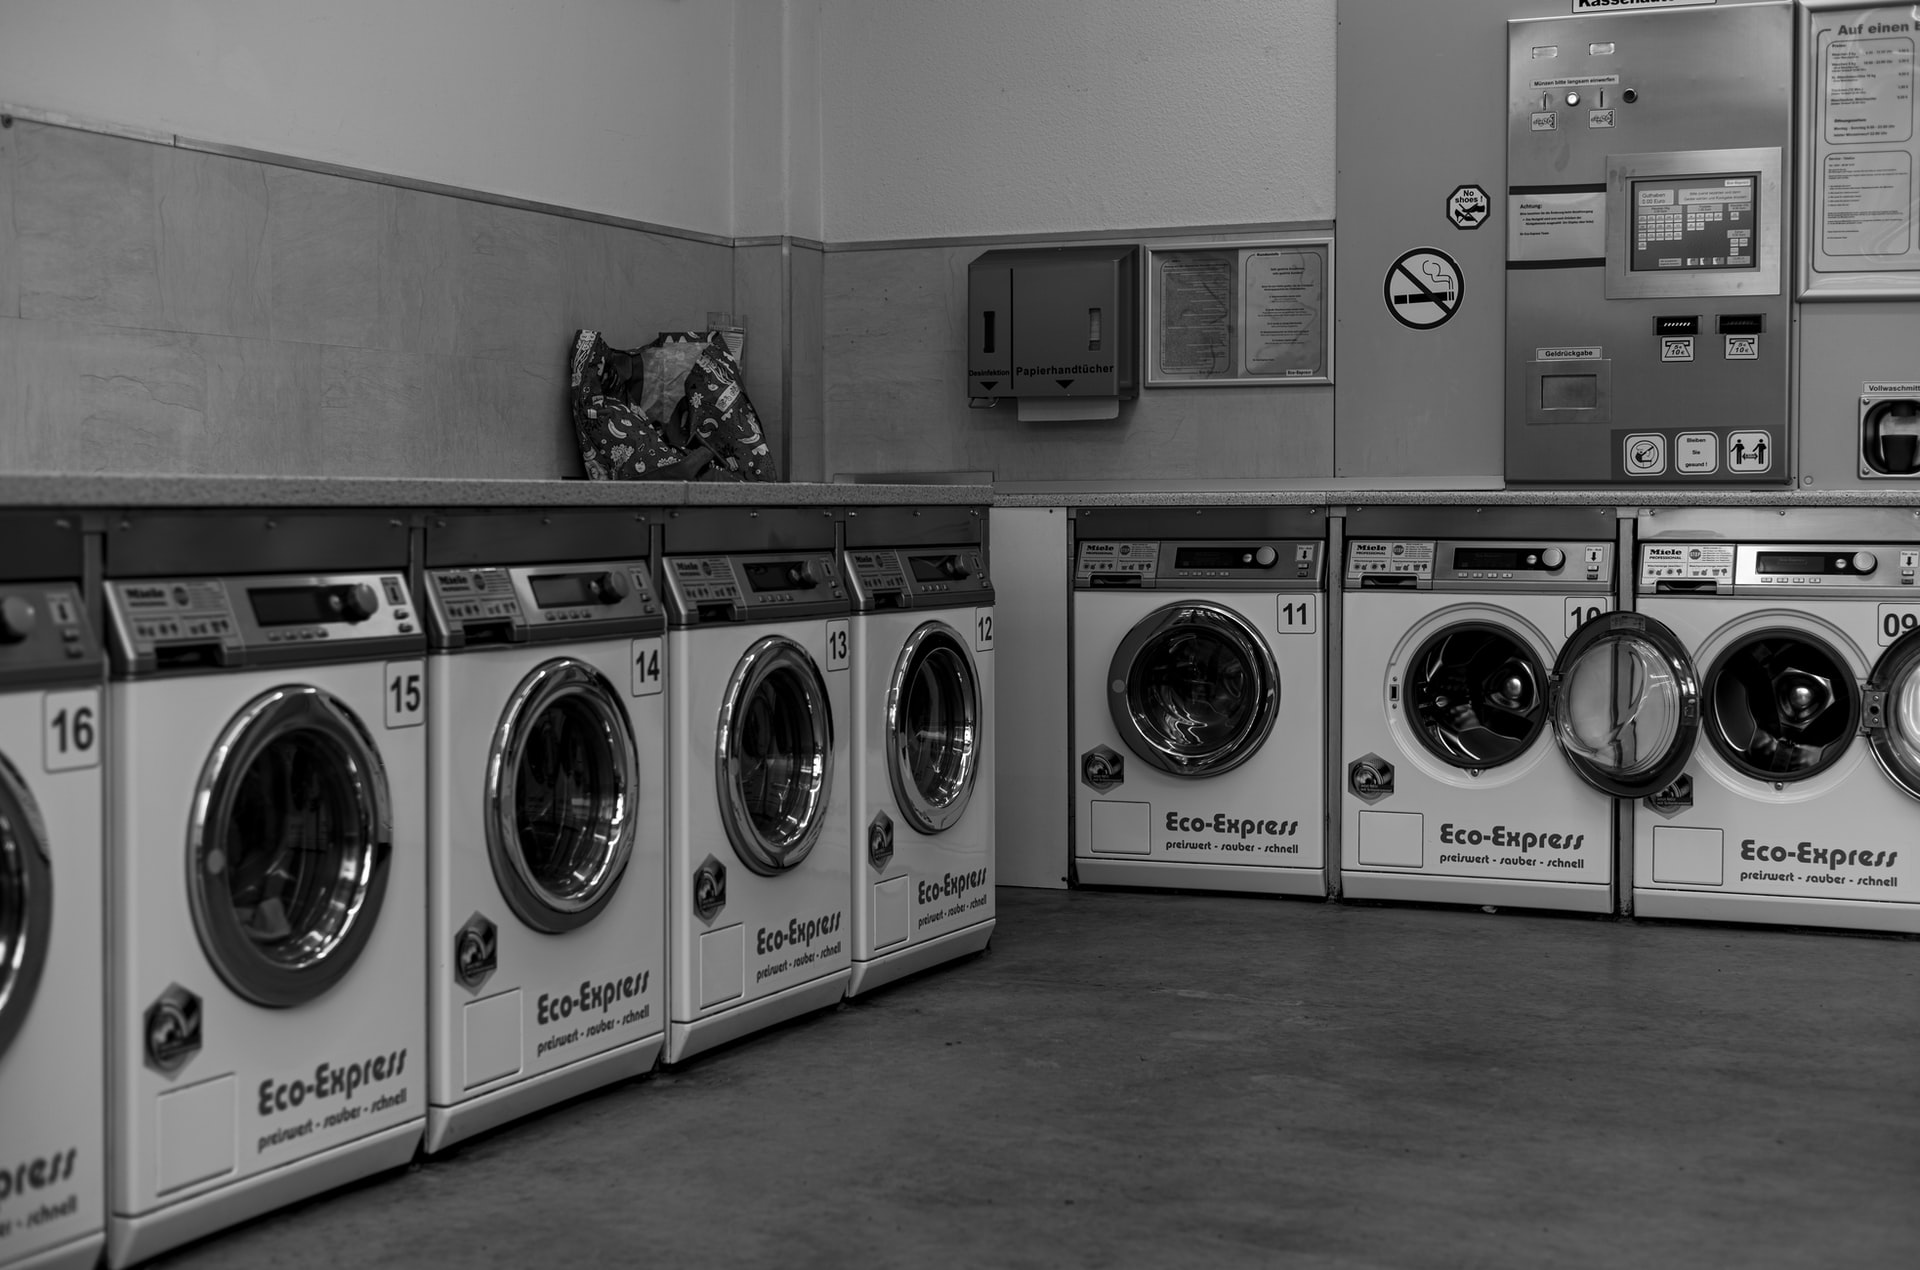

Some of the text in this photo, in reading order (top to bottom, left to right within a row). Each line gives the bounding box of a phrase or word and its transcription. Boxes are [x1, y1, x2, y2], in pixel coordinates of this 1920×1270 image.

[1838, 24, 1863, 35] Auf
[1868, 22, 1909, 34] einen
[1016, 364, 1115, 378] Papierhandtücher
[1283, 602, 1306, 625] 11
[978, 616, 992, 642] 12
[830, 631, 847, 660] 13
[636, 649, 660, 683] 14
[391, 674, 421, 714] 15
[52, 707, 93, 753] 16
[1166, 812, 1298, 839] Eco-Express
[1440, 823, 1585, 852] Eco-Express
[1166, 840, 1211, 851] preiswert
[1221, 841, 1255, 852] sauber
[1265, 843, 1298, 854] schnell
[1440, 853, 1490, 865] preiswert
[1500, 855, 1536, 866] sauber
[1547, 858, 1585, 869] schnell
[1740, 839, 1898, 870] Eco-Express
[918, 867, 987, 905] Eco-Express
[1740, 870, 1794, 882] preiswert
[1806, 873, 1845, 884] sauber
[1857, 875, 1898, 887] schnell
[757, 911, 841, 955] Eco-Express
[757, 960, 788, 984] preiswert
[793, 952, 815, 968] sauber
[820, 941, 841, 959] schnell
[537, 970, 649, 1025] Eco-Express
[537, 1028, 578, 1058] preiswert
[586, 1019, 615, 1038] sauber
[622, 1003, 650, 1026] schnell
[258, 1048, 407, 1116] Eco-Express
